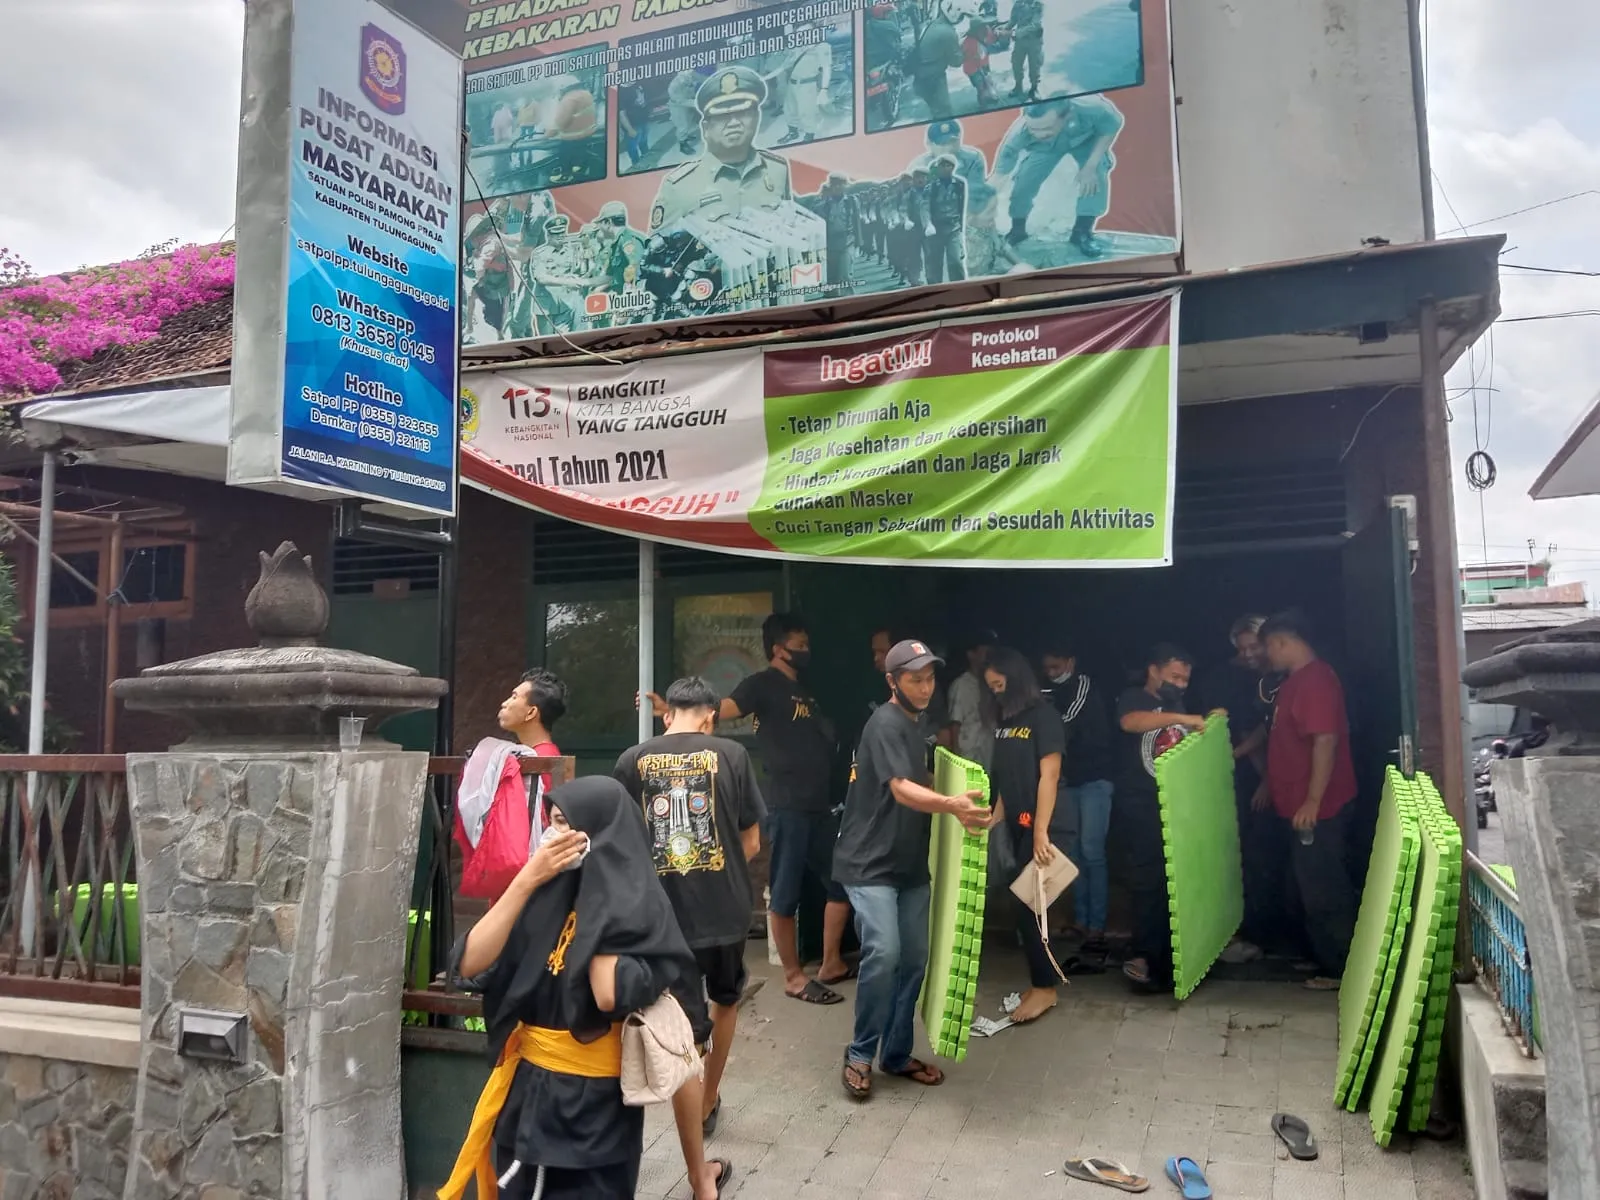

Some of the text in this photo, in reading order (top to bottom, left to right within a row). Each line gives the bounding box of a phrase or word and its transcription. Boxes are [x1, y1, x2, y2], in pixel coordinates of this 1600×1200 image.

[462, 5, 620, 60] KEBAKARAN
[465, 0, 589, 32] PEMADA
[487, 68, 526, 90] SATPOL
[528, 64, 543, 81] PP
[544, 61, 566, 77] DAN
[568, 45, 632, 73] SATLINMAS
[635, 35, 675, 57] DALAM
[678, 18, 753, 48] MENDUKUNG
[757, 2, 838, 31] PENCEGAHAN
[603, 61, 651, 88] MENUJU
[655, 53, 716, 77] INDONESIA
[719, 43, 756, 63] MAJU
[759, 36, 783, 55] DAN
[318, 87, 438, 171] INFORMASI
[300, 106, 452, 205] PUSAT ADUAN
[302, 139, 449, 230] MASYARAKAT
[307, 170, 443, 243] SATUAN POLISI PAMONG PRAJA
[315, 190, 437, 255] KABUPATEN TULUNGAGUNG
[347, 234, 409, 275] Website
[297, 238, 449, 311] satpolpp.tulungagung.go.id
[337, 289, 415, 335] Whatsapp
[608, 291, 651, 309] YouTube
[312, 305, 435, 363] 0813 3658 0145
[340, 336, 409, 371] (Khusus chat)
[971, 325, 1040, 347] Protokol
[971, 346, 1057, 368] Kesehatan
[344, 372, 403, 406] Hotline
[575, 395, 692, 416] KITA BANGSA
[577, 378, 666, 401] BANGKIT!
[301, 386, 439, 438] Satpol PP (0355) 323655
[311, 408, 431, 452] Damkar (0355) 321113
[505, 423, 560, 434] KEBANGKITAN
[577, 408, 728, 435] YANG TANGGUH
[788, 400, 931, 434] Tetap Dirumah Aja
[514, 432, 554, 441] NASIONAL
[789, 447, 821, 464] Jaga
[825, 434, 910, 457] Kesehatan
[914, 431, 943, 447] dan
[289, 446, 318, 462] JALAN
[336, 457, 369, 474] KARTINI
[369, 464, 383, 477] NO
[383, 468, 389, 478] 7
[390, 470, 447, 491] TULUNGAGUNG
[549, 451, 610, 486] Tahun
[615, 449, 669, 483] 2021
[784, 469, 840, 490] Hindari
[933, 453, 966, 474] dan
[970, 451, 1011, 474] Jaga
[1015, 445, 1062, 467] Jarak
[850, 488, 914, 507] Masker
[775, 520, 811, 534] Cuci
[814, 520, 874, 537] Tangan
[951, 514, 981, 532] dan
[986, 509, 1064, 531] Sesudah
[1070, 507, 1155, 529] Aktivitas
